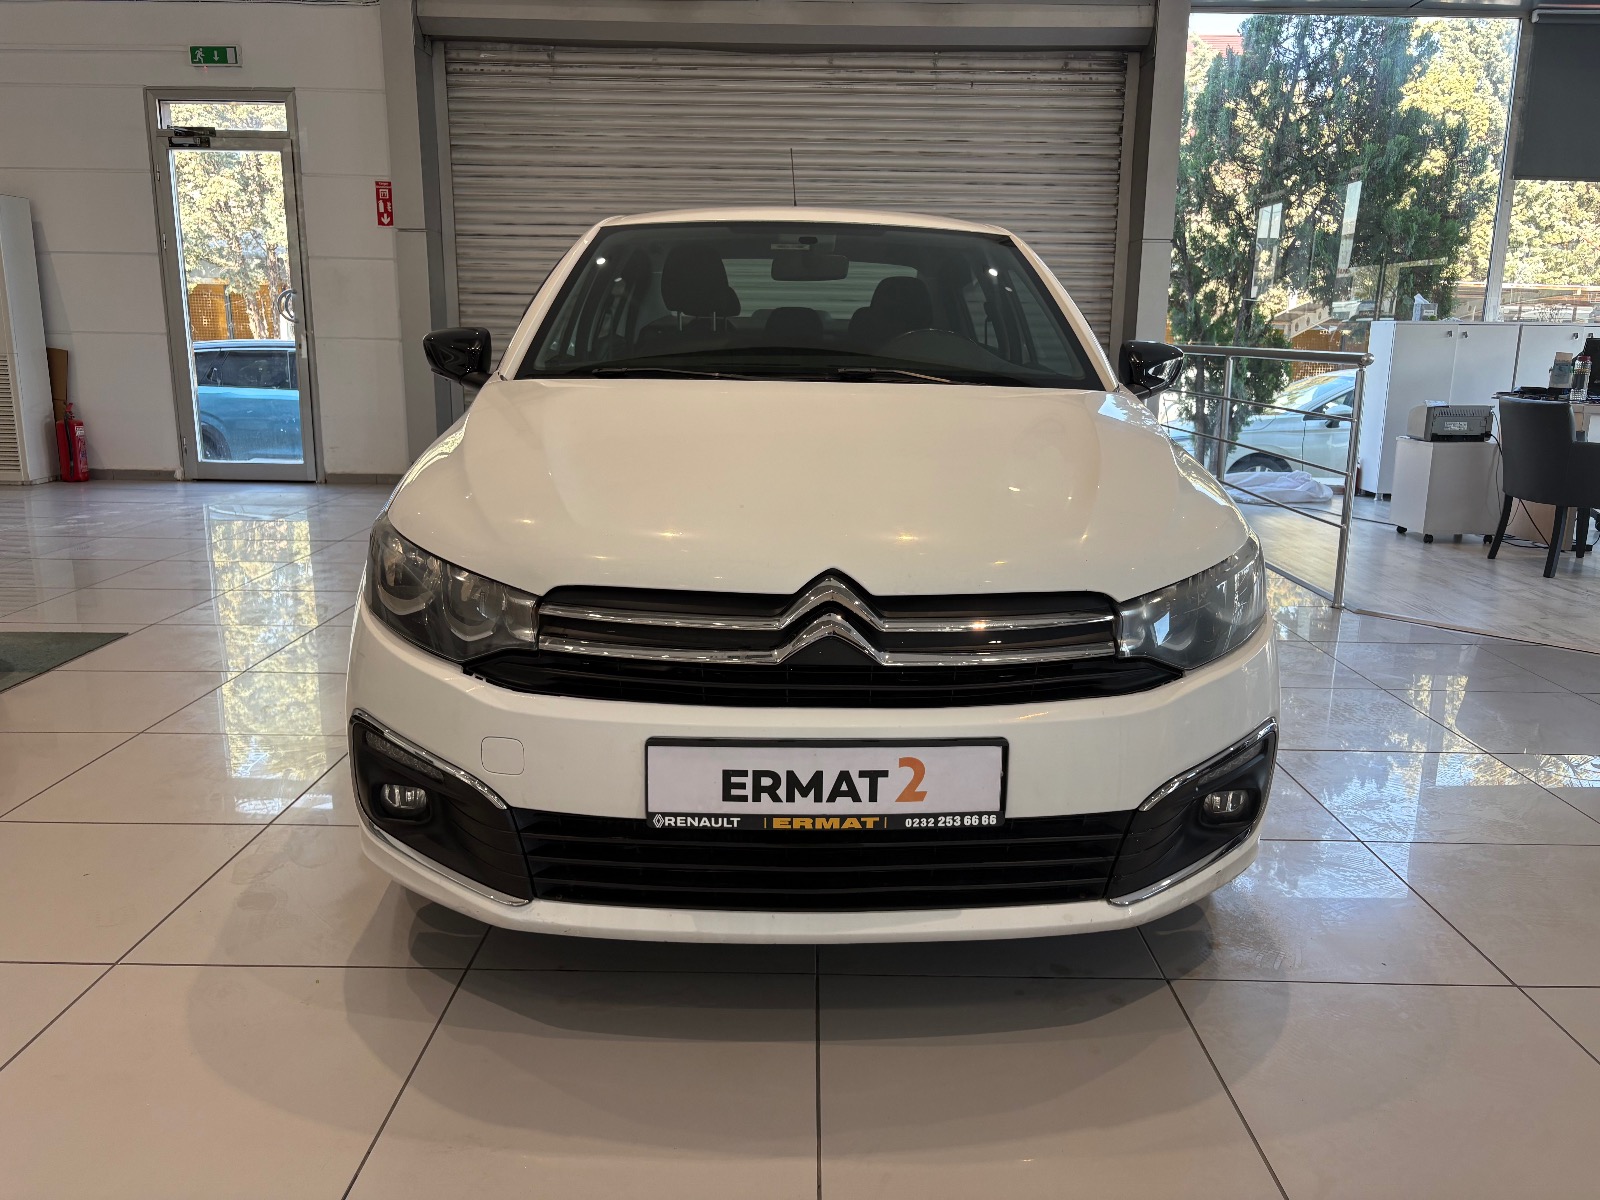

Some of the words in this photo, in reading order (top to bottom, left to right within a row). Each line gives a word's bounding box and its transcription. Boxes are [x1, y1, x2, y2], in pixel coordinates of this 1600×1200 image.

[722, 769, 889, 803] ERMAT
[895, 757, 928, 802] 2
[664, 816, 741, 828] RENAULT
[772, 817, 880, 829] ERMAT
[905, 818, 935, 828] 0232
[937, 815, 961, 827] 253
[963, 815, 979, 826] 66
[981, 814, 997, 825] 66
